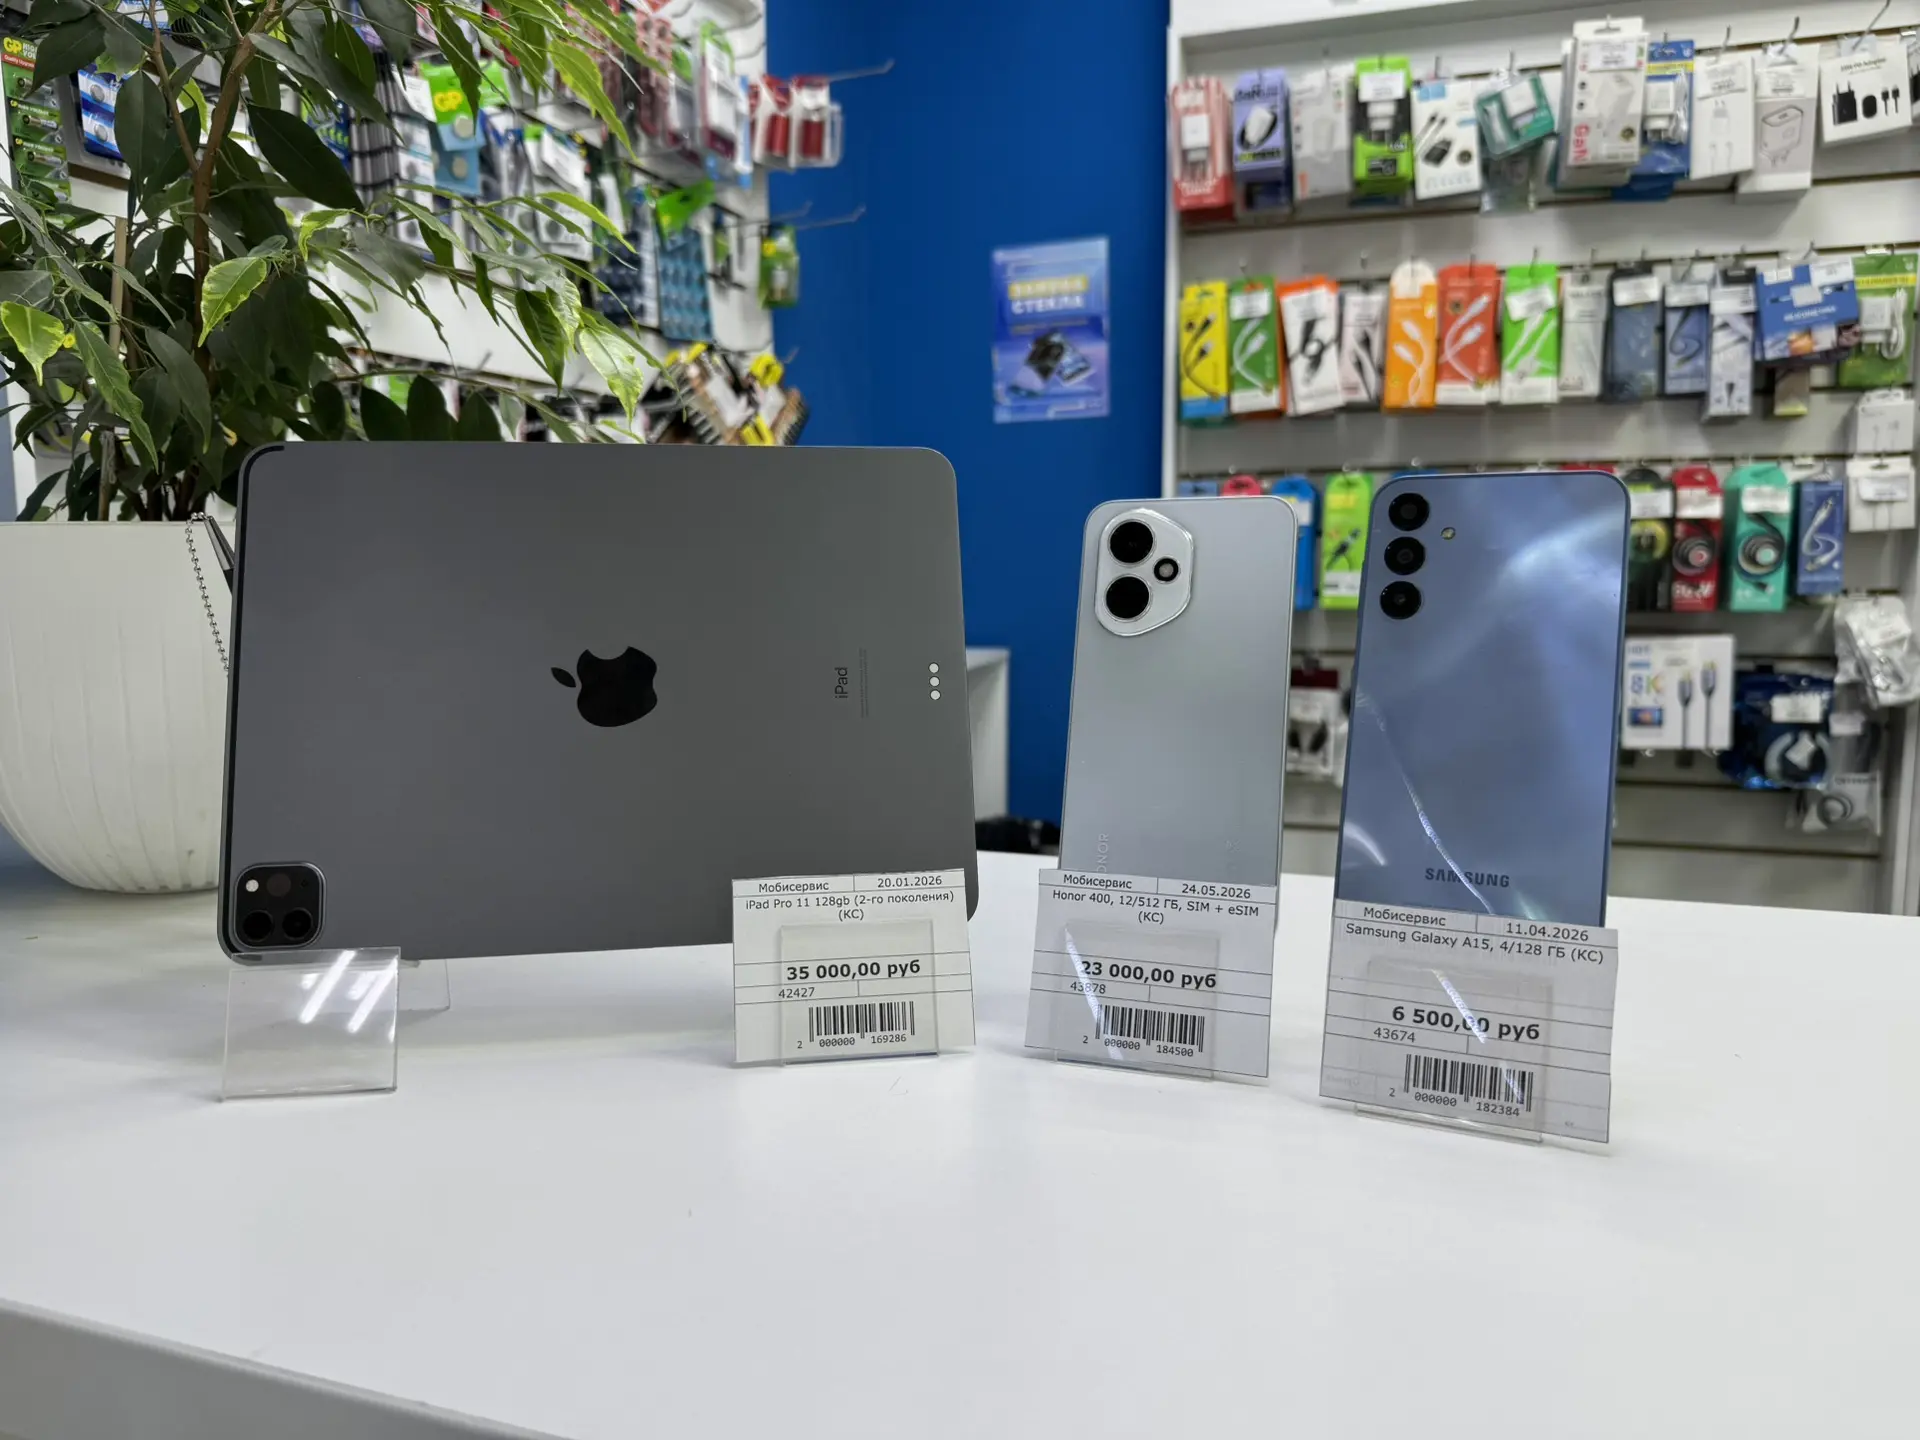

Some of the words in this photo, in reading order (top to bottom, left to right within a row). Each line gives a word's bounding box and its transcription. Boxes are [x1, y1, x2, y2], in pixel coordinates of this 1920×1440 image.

[3, 37, 22, 54] GP
[434, 90, 462, 112] GP
[834, 667, 848, 699] iPad
[1096, 833, 1109, 873] ONOR
[758, 881, 829, 893] Мобисервис
[877, 876, 943, 888] 20.01.2026
[1063, 874, 1132, 889] Мобисервис
[1425, 868, 1510, 888] SAMSUNG
[745, 899, 770, 910] iPad
[774, 898, 792, 909] Pro
[797, 897, 810, 908] 11
[816, 895, 850, 909] 128gb
[854, 894, 884, 907] (2-го
[887, 890, 955, 904] поколения)
[1181, 883, 1251, 899] 24.05.2026
[1053, 890, 1086, 902] Honor
[1089, 893, 1114, 906] 400,
[1119, 894, 1160, 908] 12/512
[1187, 901, 1210, 913] SIM
[1215, 905, 1223, 913] +
[1228, 905, 1259, 917] eSIM
[1363, 907, 1446, 927] Мобисервис
[1346, 923, 1406, 942] Samsung
[1411, 931, 1457, 948] Galaxy
[1462, 937, 1494, 952] A15,
[1500, 940, 1542, 956] 4/128
[1547, 946, 1565, 958] ГБ
[1506, 922, 1589, 942] 11.04.2026
[787, 965, 810, 981] 35
[816, 962, 881, 980] 000,00
[887, 959, 920, 978] руб
[1080, 960, 1102, 975] 23
[1109, 963, 1175, 984] 000,00
[1181, 973, 1217, 989] руб
[778, 987, 815, 999] 42427
[1070, 982, 1106, 994] 43878
[1392, 1005, 1405, 1021] 6
[1412, 1008, 1490, 1033] 500,00
[1498, 1022, 1540, 1041] руб
[797, 1041, 803, 1049] 2
[819, 1037, 855, 1048] 000000
[870, 1033, 907, 1044] 169286
[1373, 1027, 1416, 1043] 43674
[1083, 1035, 1089, 1044] 2
[1104, 1038, 1141, 1050] 000000
[1156, 1044, 1194, 1058] 184500
[1389, 1088, 1396, 1098] 2
[1414, 1092, 1457, 1107] 000000
[1475, 1101, 1520, 1117] 182384
